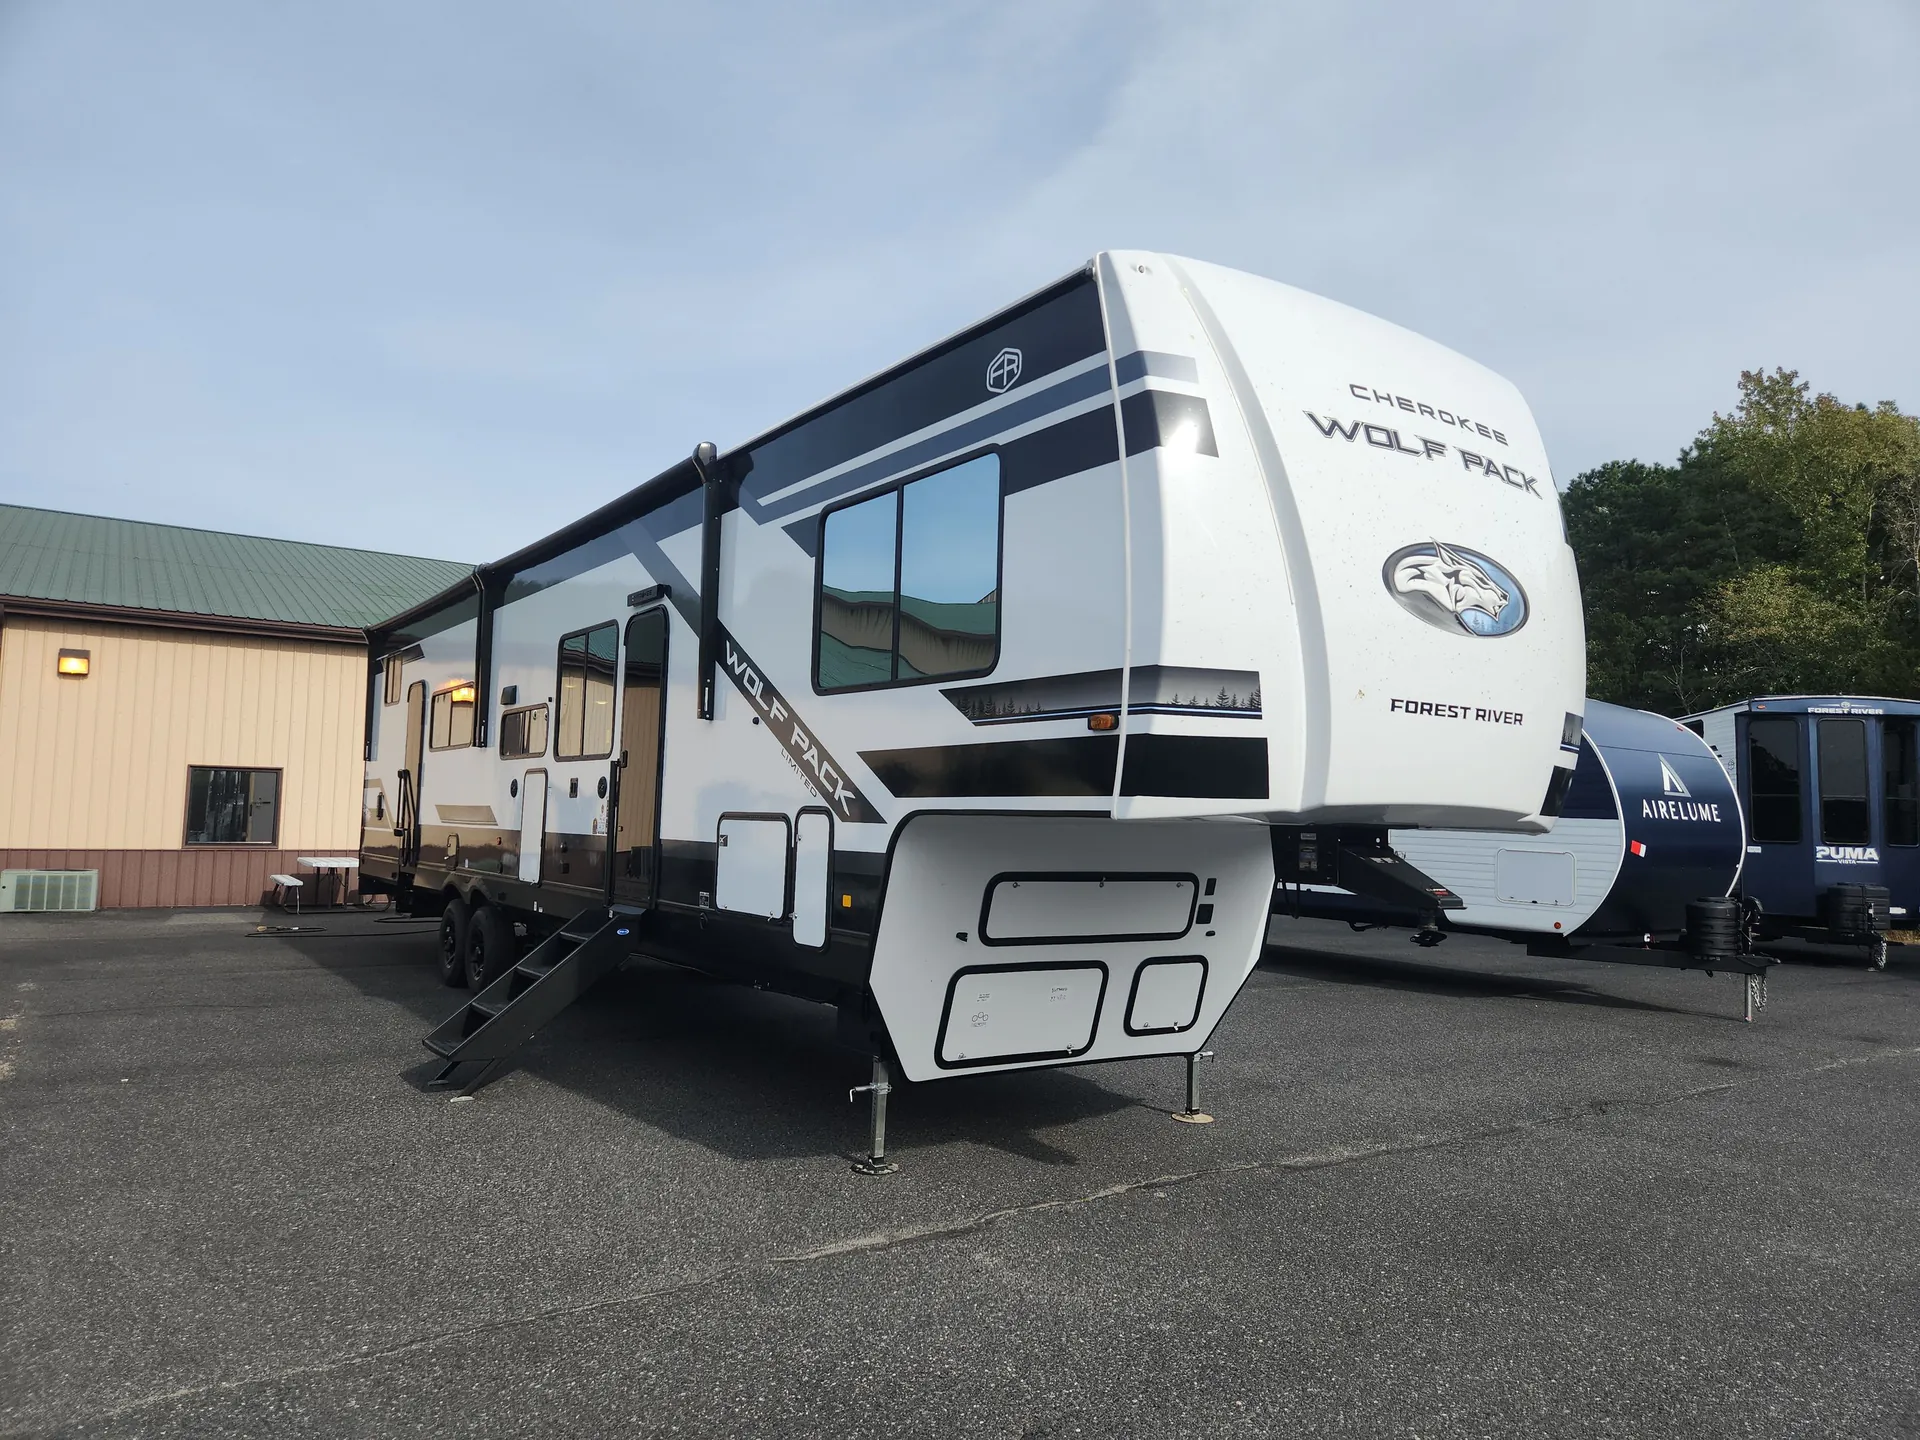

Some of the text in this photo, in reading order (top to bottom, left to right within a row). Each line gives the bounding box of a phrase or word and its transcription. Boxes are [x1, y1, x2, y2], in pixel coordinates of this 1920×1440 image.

[1349, 384, 1509, 447] CHEROKEE
[1303, 410, 1543, 500] WOLF PACK
[726, 640, 856, 816] WOLF PACK
[1390, 698, 1524, 726] FOREST RIVER
[780, 748, 817, 797] LIMITED
[1642, 799, 1721, 822] AIRELUME
[1815, 846, 1880, 860] PUMA
